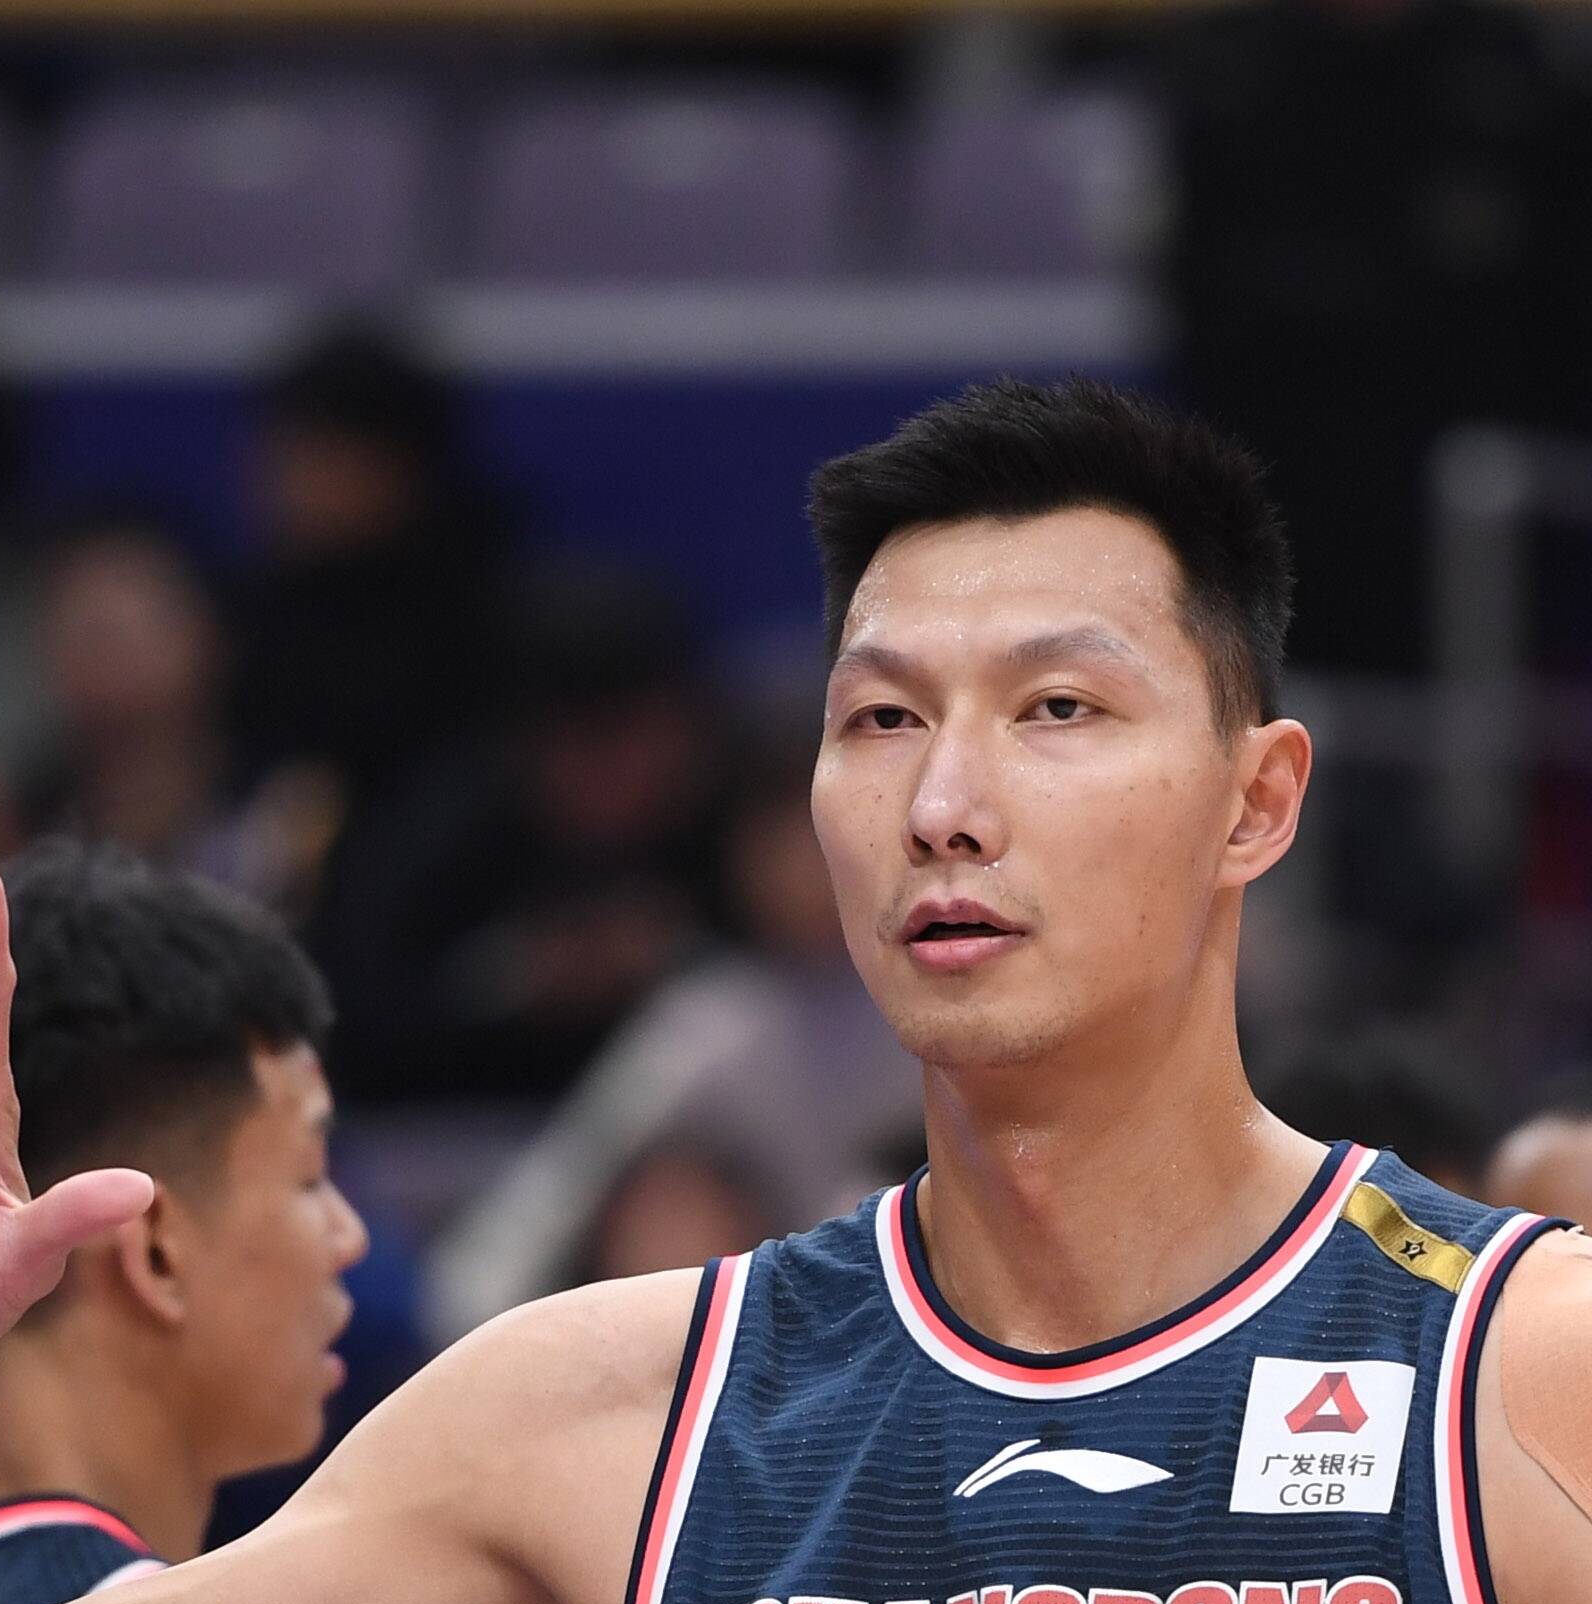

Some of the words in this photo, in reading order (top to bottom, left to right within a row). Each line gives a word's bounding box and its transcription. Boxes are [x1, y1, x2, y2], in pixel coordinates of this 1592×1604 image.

[1260, 1453, 1376, 1477] 广发银行
[1279, 1482, 1346, 1507] CGB
